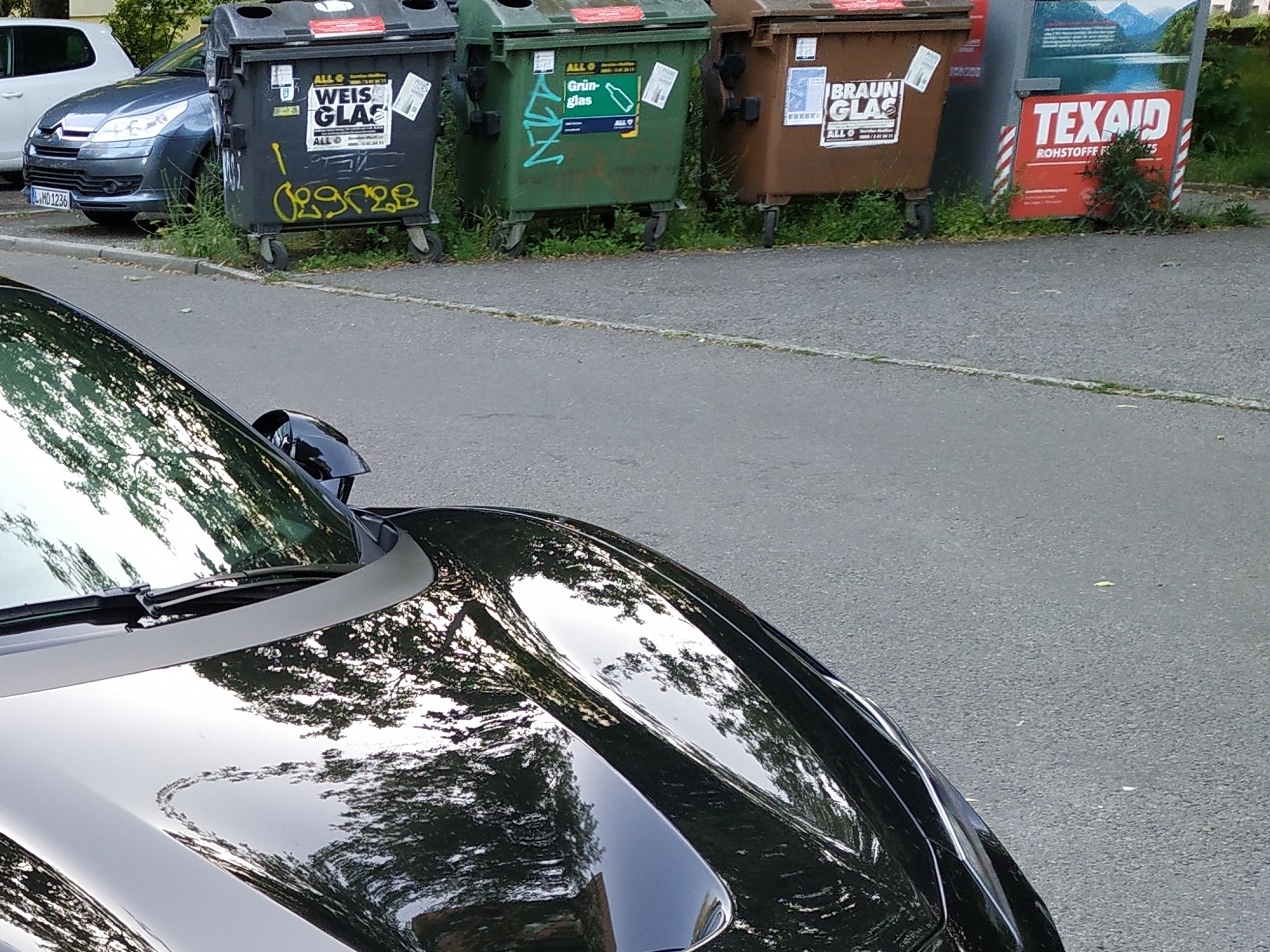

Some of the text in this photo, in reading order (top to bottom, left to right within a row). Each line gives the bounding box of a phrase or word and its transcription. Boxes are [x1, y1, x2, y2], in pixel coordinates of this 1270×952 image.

[314, 75, 334, 84] ALL
[567, 79, 600, 92] Grün-
[315, 87, 371, 105] WEIS
[831, 81, 898, 99] BRAUN
[567, 95, 592, 109] glas
[1033, 98, 1171, 145] TEXAID
[826, 129, 845, 138] ALL
[1035, 145, 1099, 159] ROHSTOFFE
